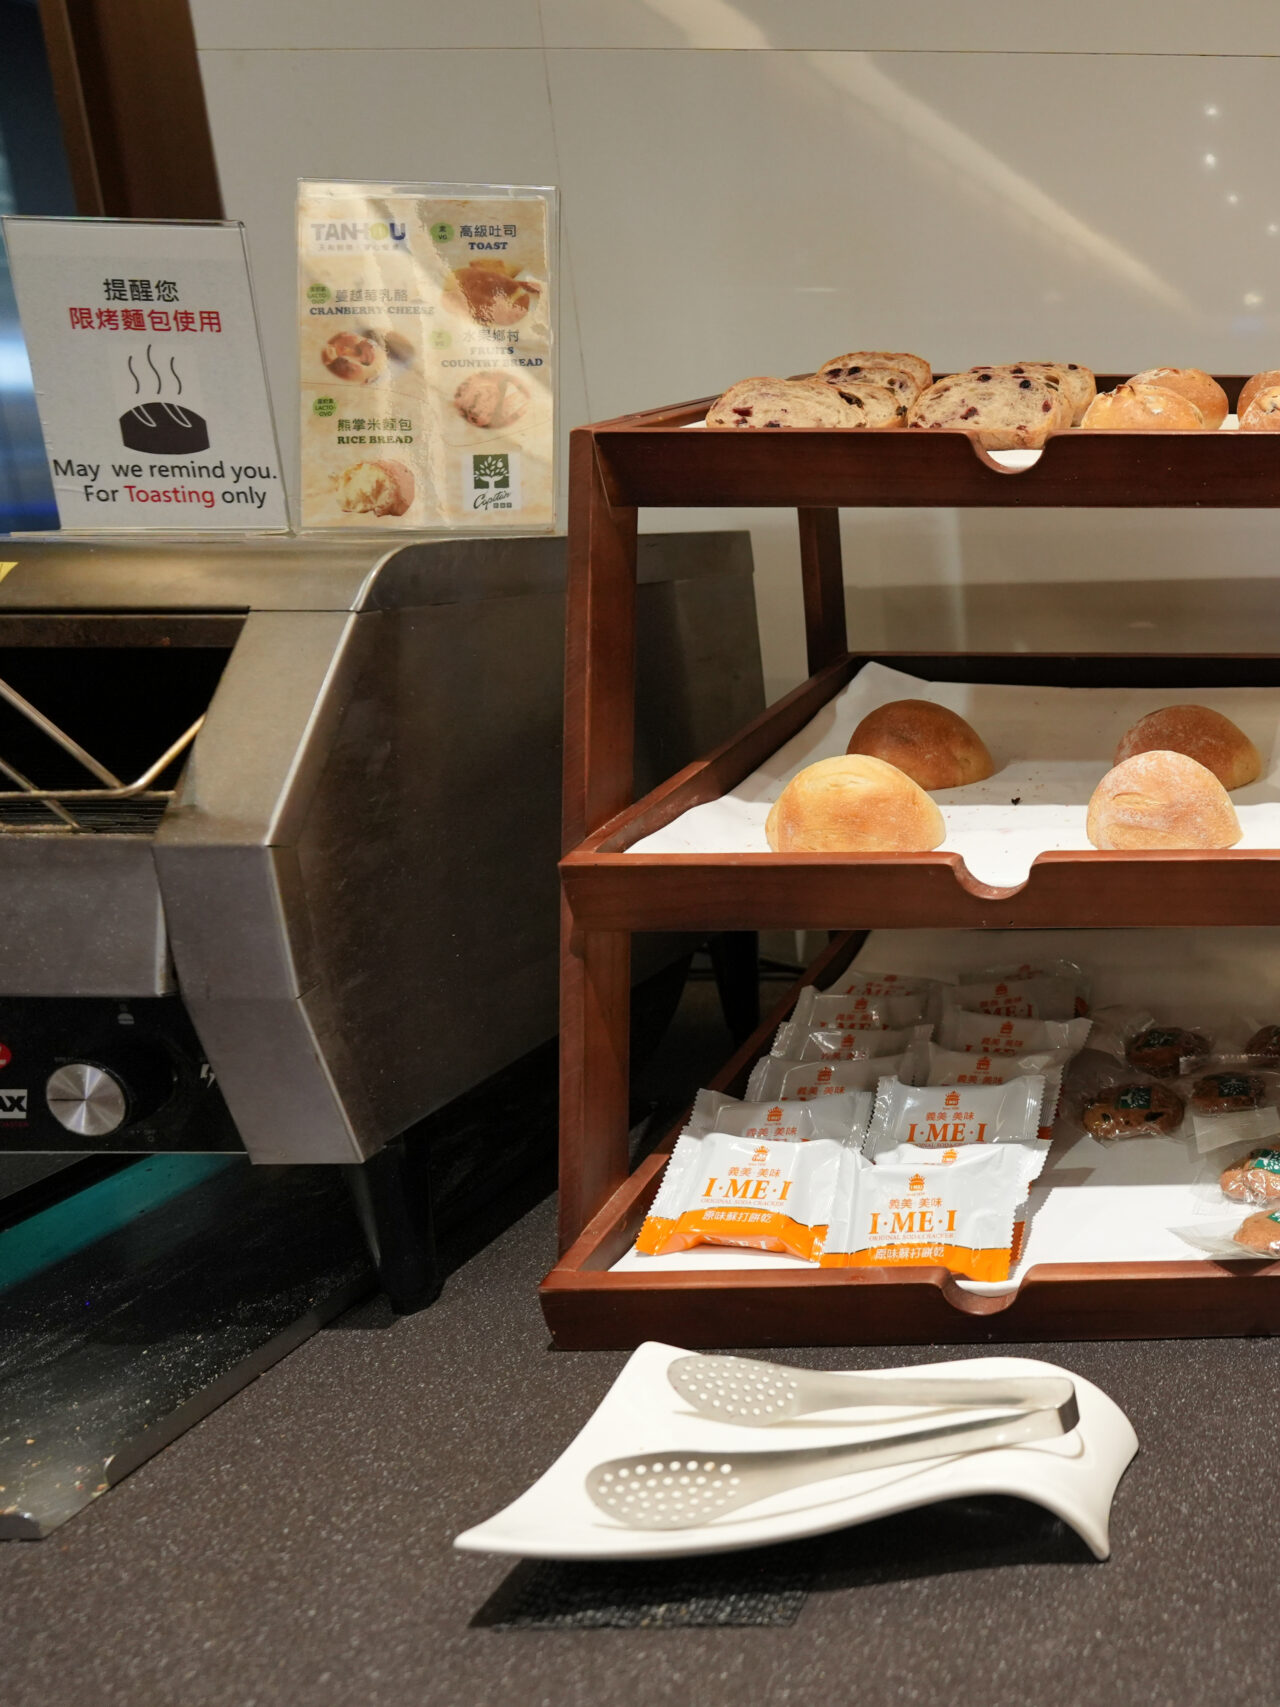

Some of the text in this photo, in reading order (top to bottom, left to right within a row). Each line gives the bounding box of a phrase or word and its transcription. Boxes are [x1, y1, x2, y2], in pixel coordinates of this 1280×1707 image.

[460, 224, 517, 238] 高級吐司
[468, 242, 508, 250] TOAST
[103, 279, 179, 302] 提醒您
[310, 306, 435, 316] CRANBERRY CHEESE
[69, 307, 222, 333] 限烤麵包使用
[441, 359, 498, 368] COUNTRY
[337, 435, 413, 444] RICE BREAD
[53, 459, 277, 484] May we remind you.
[84, 485, 266, 509] For Toasting only
